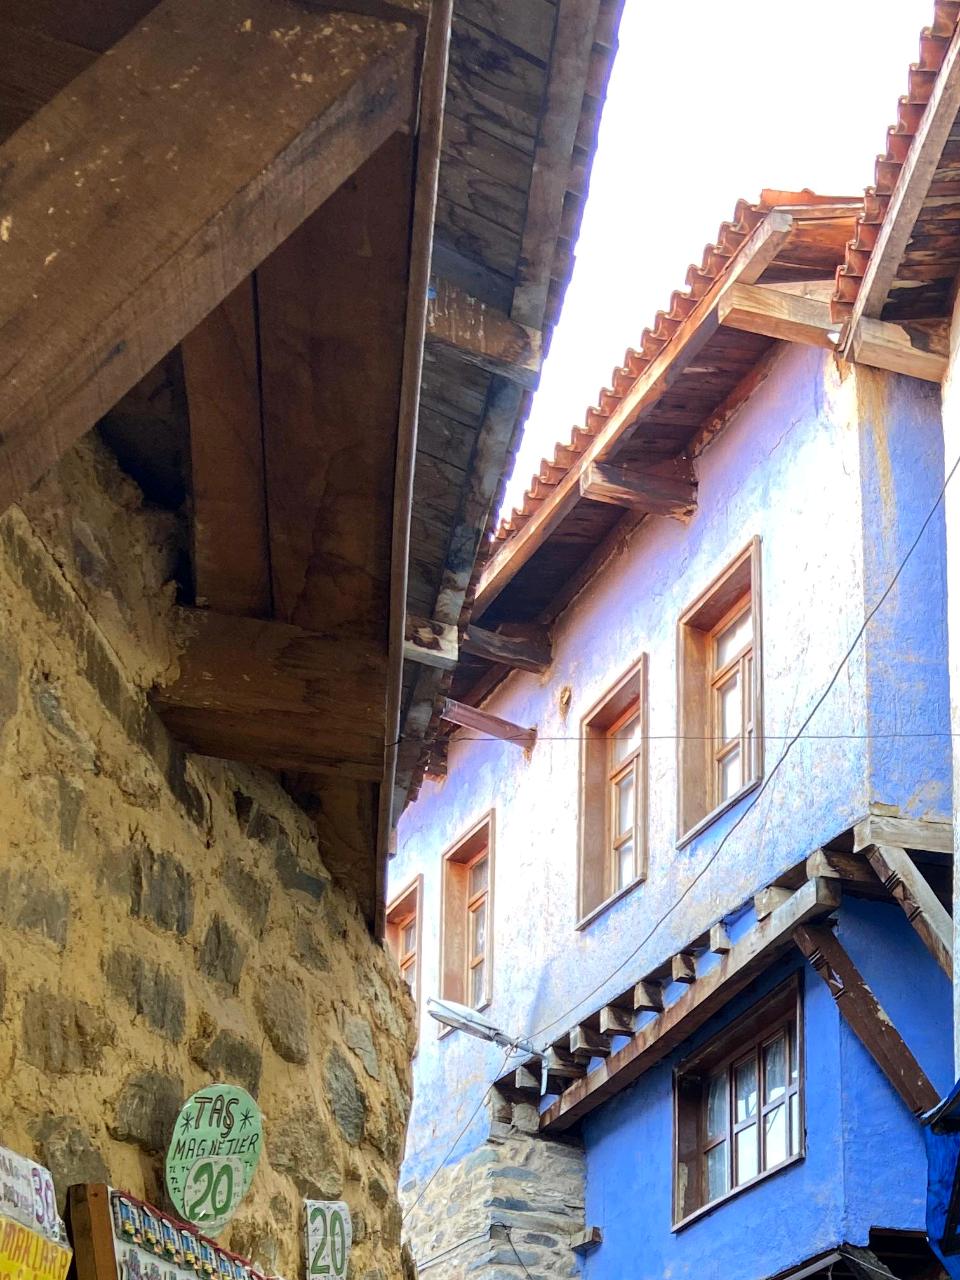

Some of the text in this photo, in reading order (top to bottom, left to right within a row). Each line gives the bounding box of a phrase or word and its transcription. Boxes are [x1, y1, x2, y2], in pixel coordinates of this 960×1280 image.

[194, 1094, 239, 1138] TAŞ
[173, 1133, 259, 1160] MAGNETLER
[188, 1162, 233, 1221] 20
[310, 1207, 346, 1276] 20
